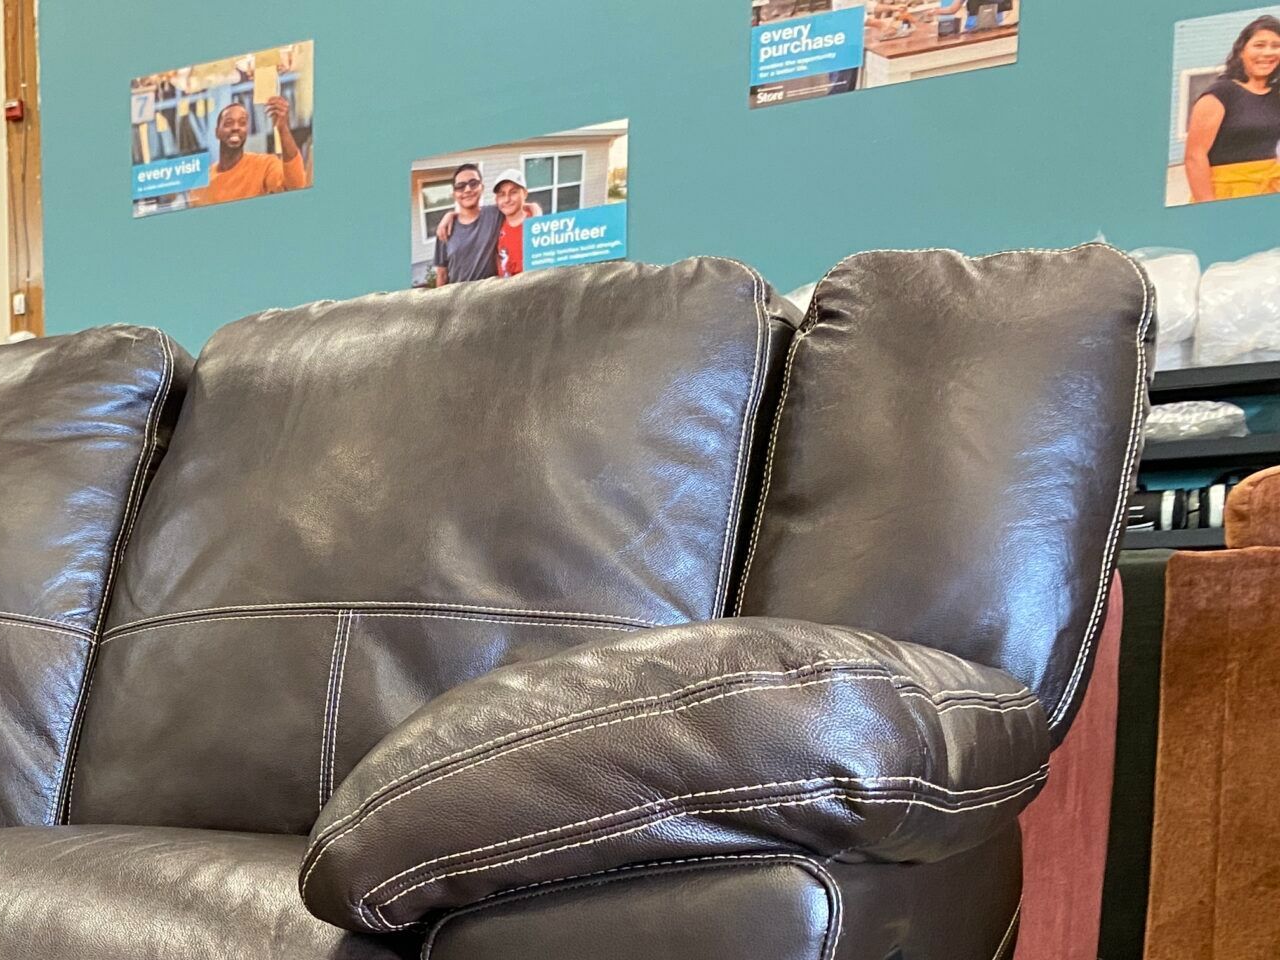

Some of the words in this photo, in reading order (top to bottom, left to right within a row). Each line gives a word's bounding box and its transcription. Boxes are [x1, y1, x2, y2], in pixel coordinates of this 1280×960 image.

[760, 24, 811, 44] every
[759, 32, 846, 62] purchase
[137, 166, 173, 183] every
[174, 158, 201, 176] visit
[531, 216, 575, 235] every
[531, 225, 608, 248] volunteer
